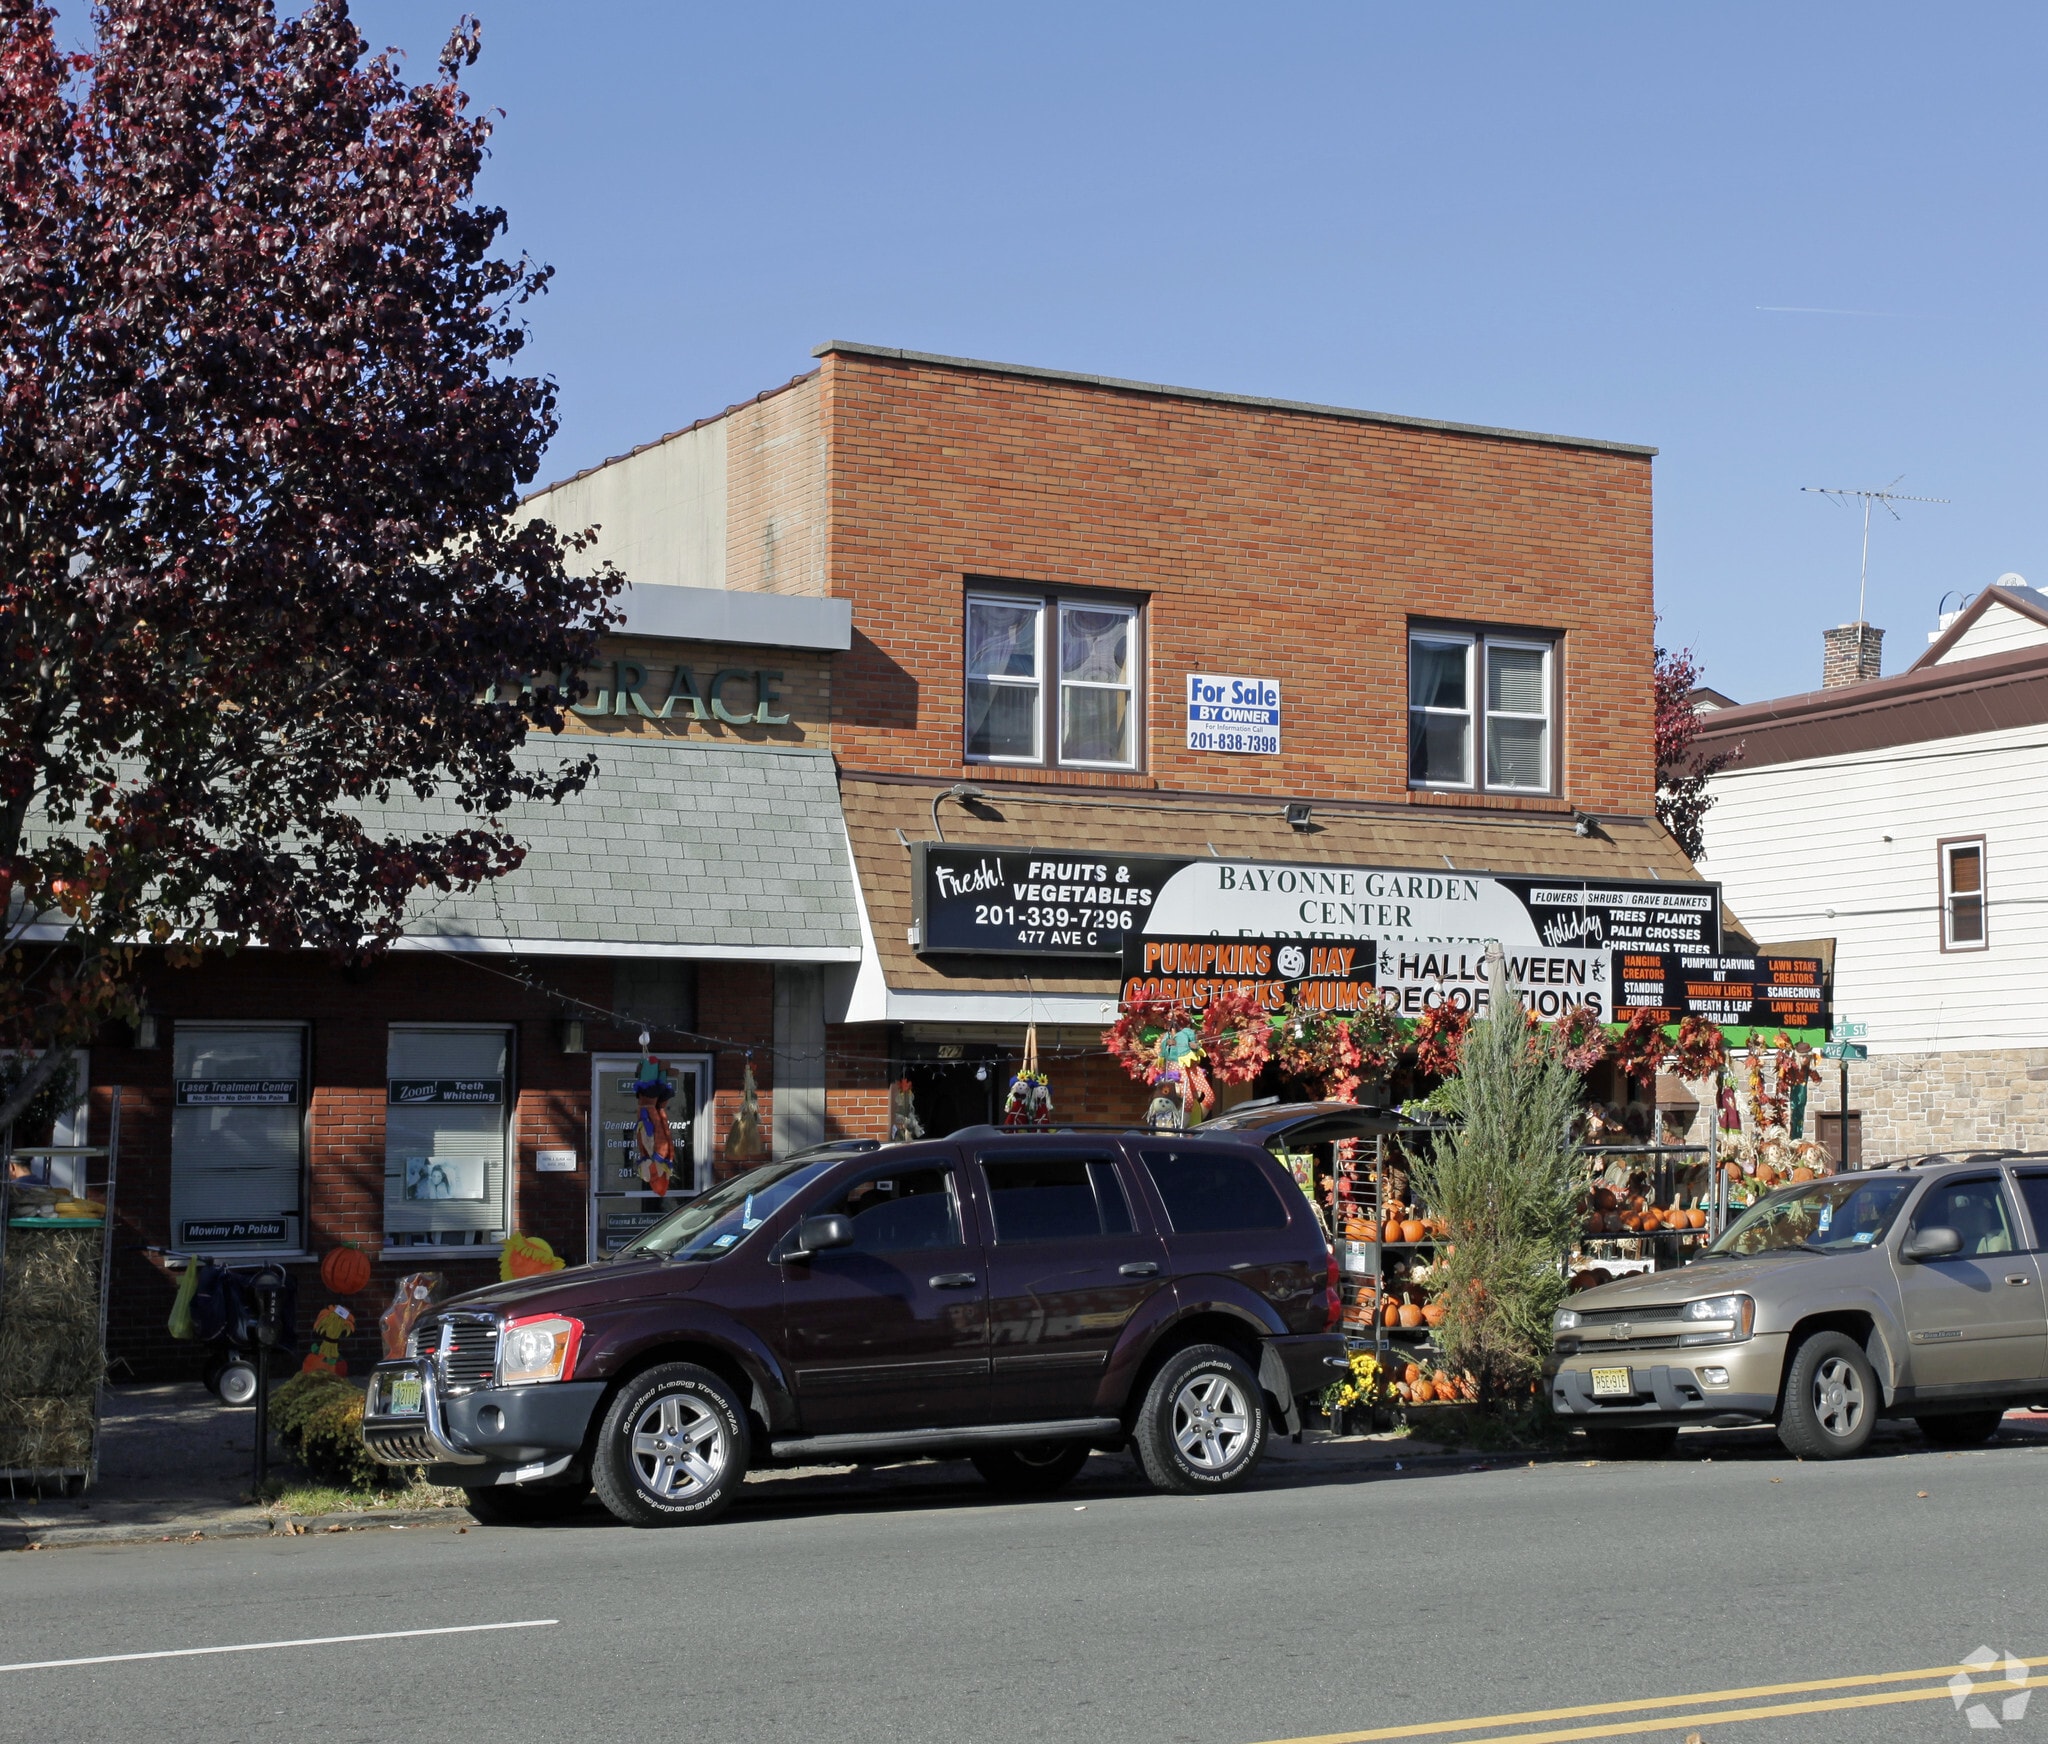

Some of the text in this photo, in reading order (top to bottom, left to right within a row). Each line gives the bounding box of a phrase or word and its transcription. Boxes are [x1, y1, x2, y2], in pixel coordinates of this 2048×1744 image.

[560, 659, 790, 725] GRACE
[1192, 678, 1277, 706] For Sale
[1199, 706, 1270, 723] BY OWNER
[1217, 724, 1251, 732] Information
[1191, 732, 1276, 752] 201-838-7398
[936, 858, 1004, 898] Fresh!
[1028, 862, 1130, 883] FRUITS &
[1219, 866, 1480, 901] BAYONNE GARDEN
[1013, 884, 1152, 906] VEGETABLES
[1536, 892, 1578, 903] FLOWERS
[1588, 893, 1624, 904] SHRUBS
[1632, 895, 1660, 906] GRAVE
[1663, 896, 1708, 907] BLANKETS
[975, 905, 1132, 929] 201-339-7296
[1300, 900, 1413, 927] CENTER
[1609, 910, 1646, 922] TREES
[1657, 912, 1702, 925] PLANTS
[1543, 911, 1603, 948] Holiday
[1610, 925, 1701, 940] PALM CROSSES
[1018, 931, 1097, 945] 477 AVE C
[1602, 940, 1710, 954] CHRISTMAS TREES
[1144, 942, 1355, 977] PUMPKINS HAY
[1624, 955, 1661, 967] HANGING
[1681, 957, 1755, 970] PUMPKIN CARVING
[1769, 960, 1817, 972] LAWN STAKE
[1623, 968, 1665, 980] CREATORS
[1713, 971, 1726, 982] KIT
[1773, 972, 1814, 984] CREATORS
[1624, 982, 1664, 994] STANDING
[1687, 984, 1752, 997] WINDOW LIGHTS
[1767, 987, 1820, 998] SCARECROWS
[1300, 981, 1373, 1012] MUMS
[1382, 986, 1603, 1018] DECORTIONS
[1626, 995, 1663, 1007] ZOMBIES
[1689, 1000, 1752, 1012] WREATH & LEAF
[1771, 1001, 1819, 1013] LAWN STAKE
[1617, 1009, 1670, 1022] INFLBLES
[1783, 1014, 1808, 1025] SIGNS
[1825, 1046, 1862, 1057] AVE C
[181, 1082, 294, 1092] Laser Treatment Center
[400, 1081, 438, 1099] Zoom!
[455, 1081, 484, 1090] Teeth
[443, 1091, 496, 1101] Whitening
[604, 1120, 638, 1130] "Dentistr
[189, 1224, 280, 1237] Mowimy Po Polsku
[658, 1380, 695, 1392] Long
[698, 1383, 728, 1410] Trail
